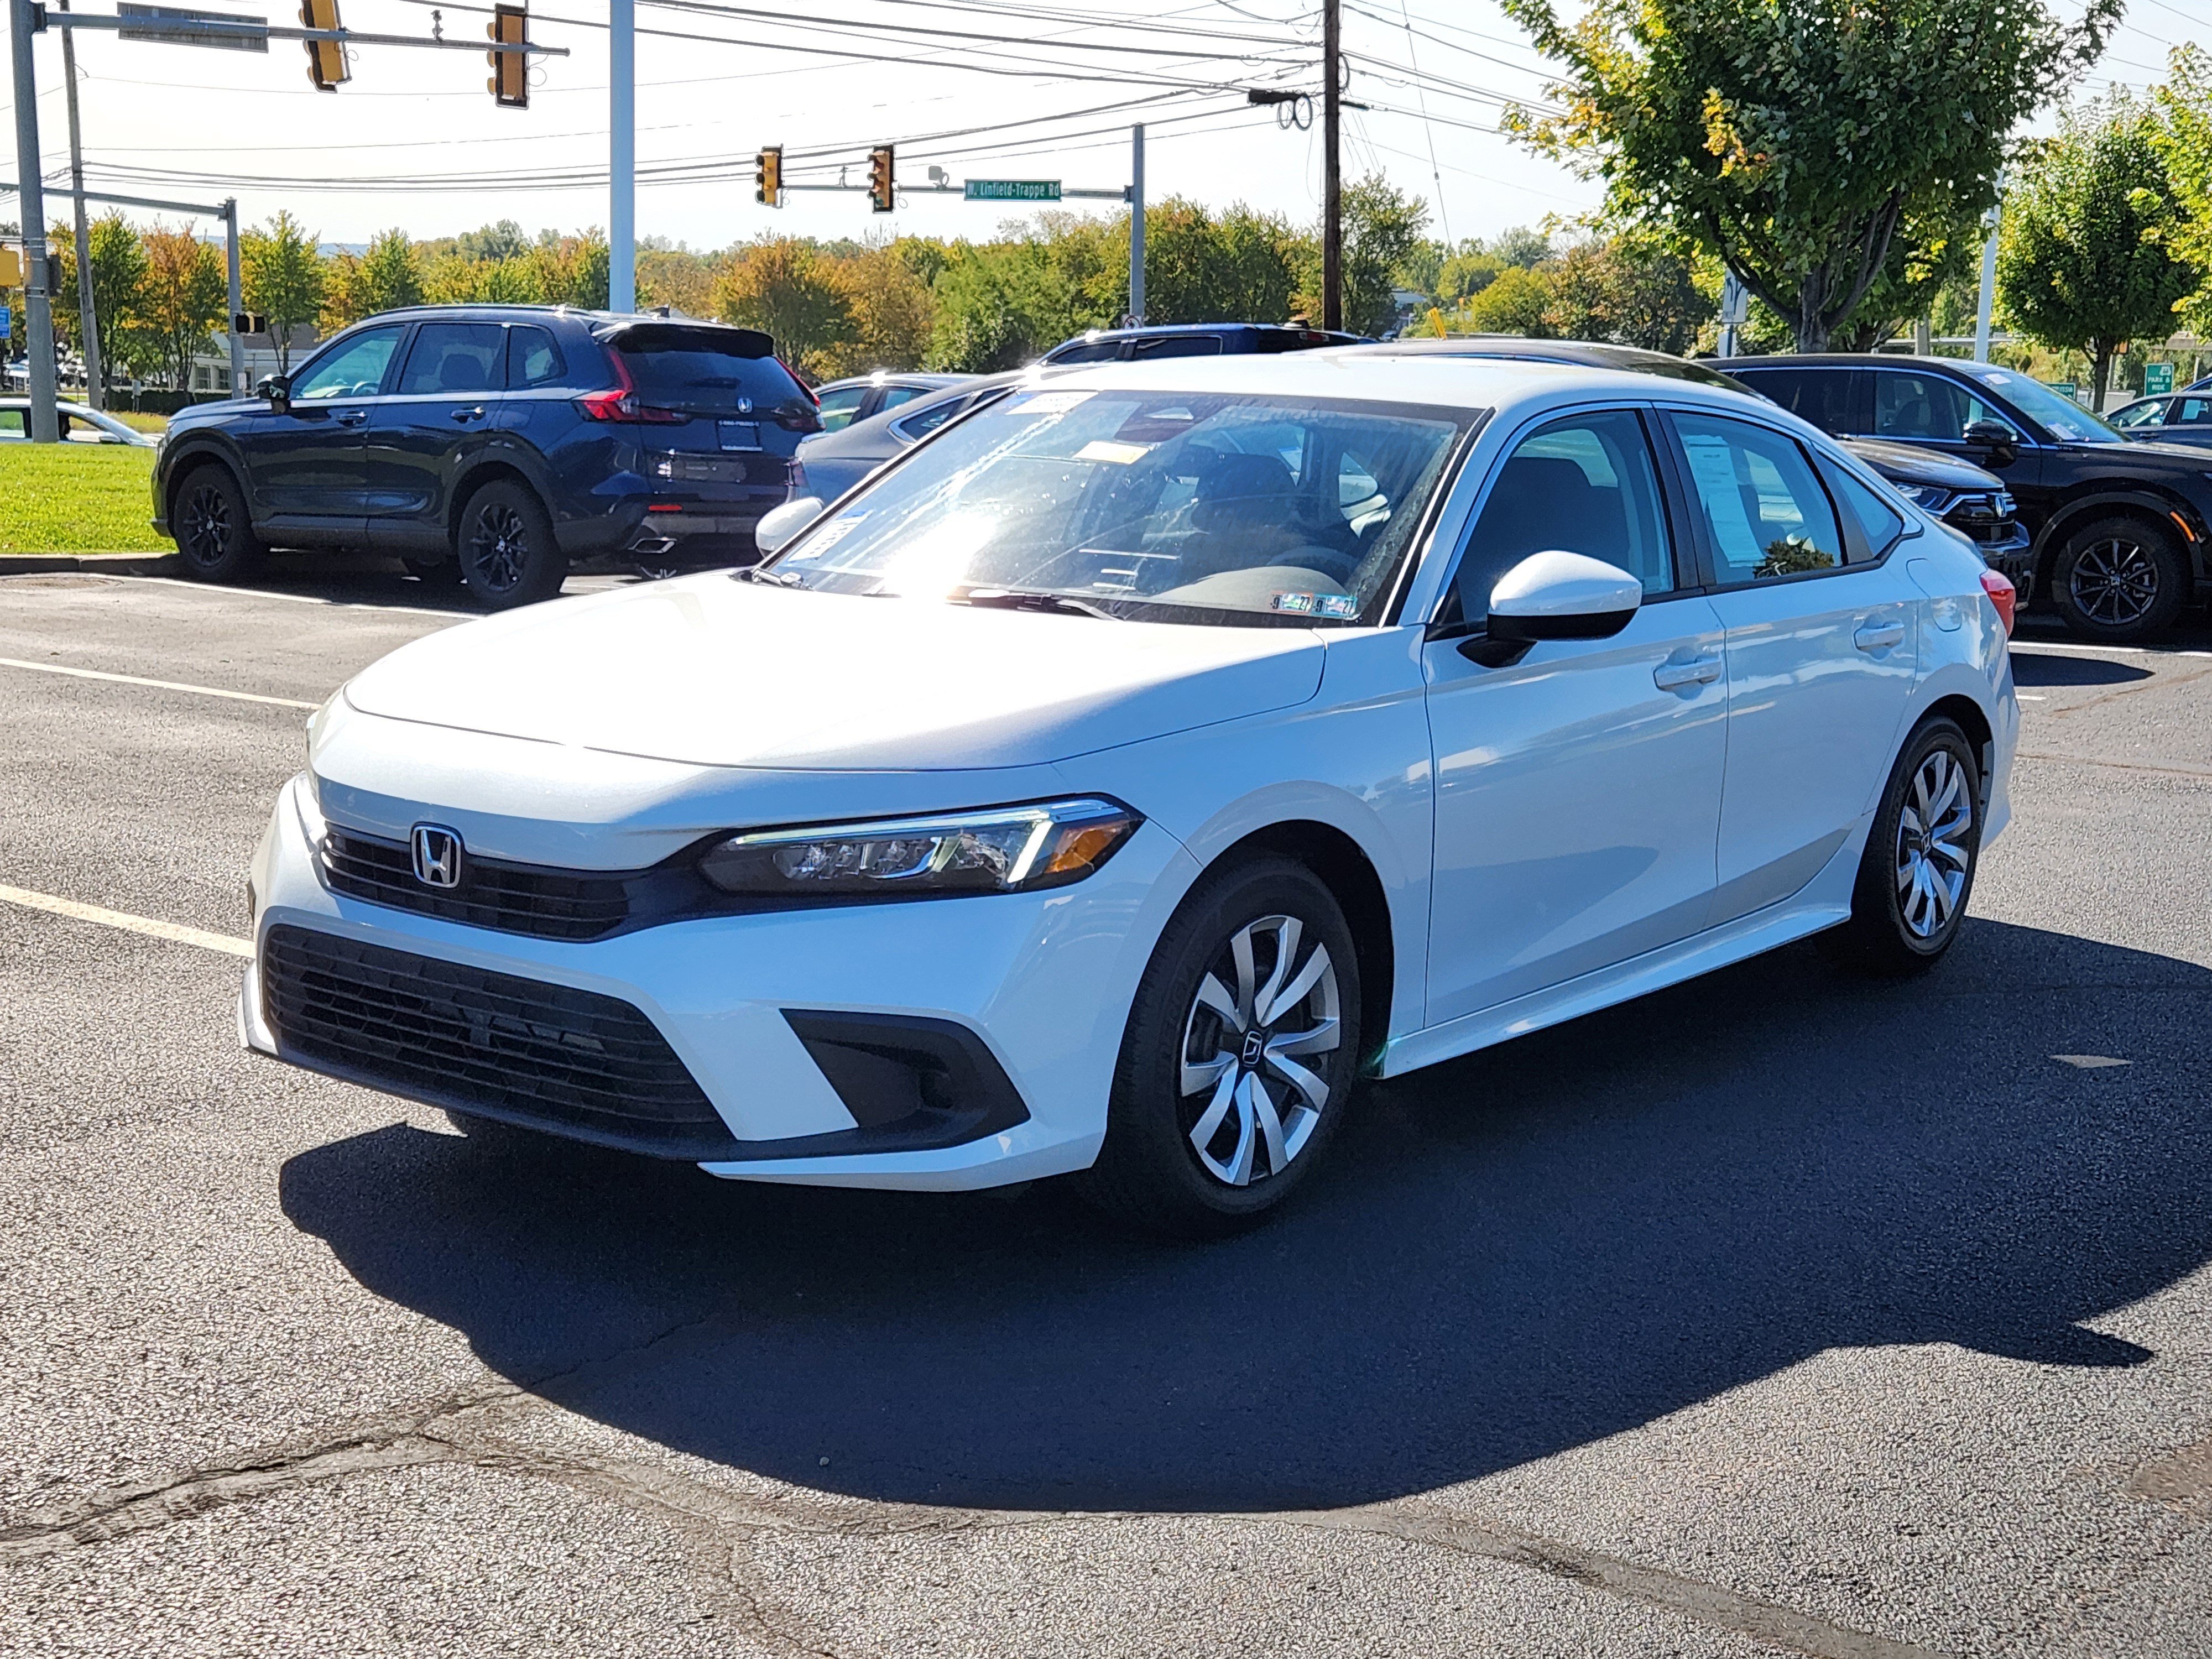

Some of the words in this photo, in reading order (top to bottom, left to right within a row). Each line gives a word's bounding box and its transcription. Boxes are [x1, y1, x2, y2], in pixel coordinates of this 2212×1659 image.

[967, 182, 977, 196] W.
[980, 182, 1045, 199] Linfield-Trappe
[1048, 184, 1059, 197] Rd
[1298, 596, 1311, 612] 27
[1342, 599, 1354, 614] 27
